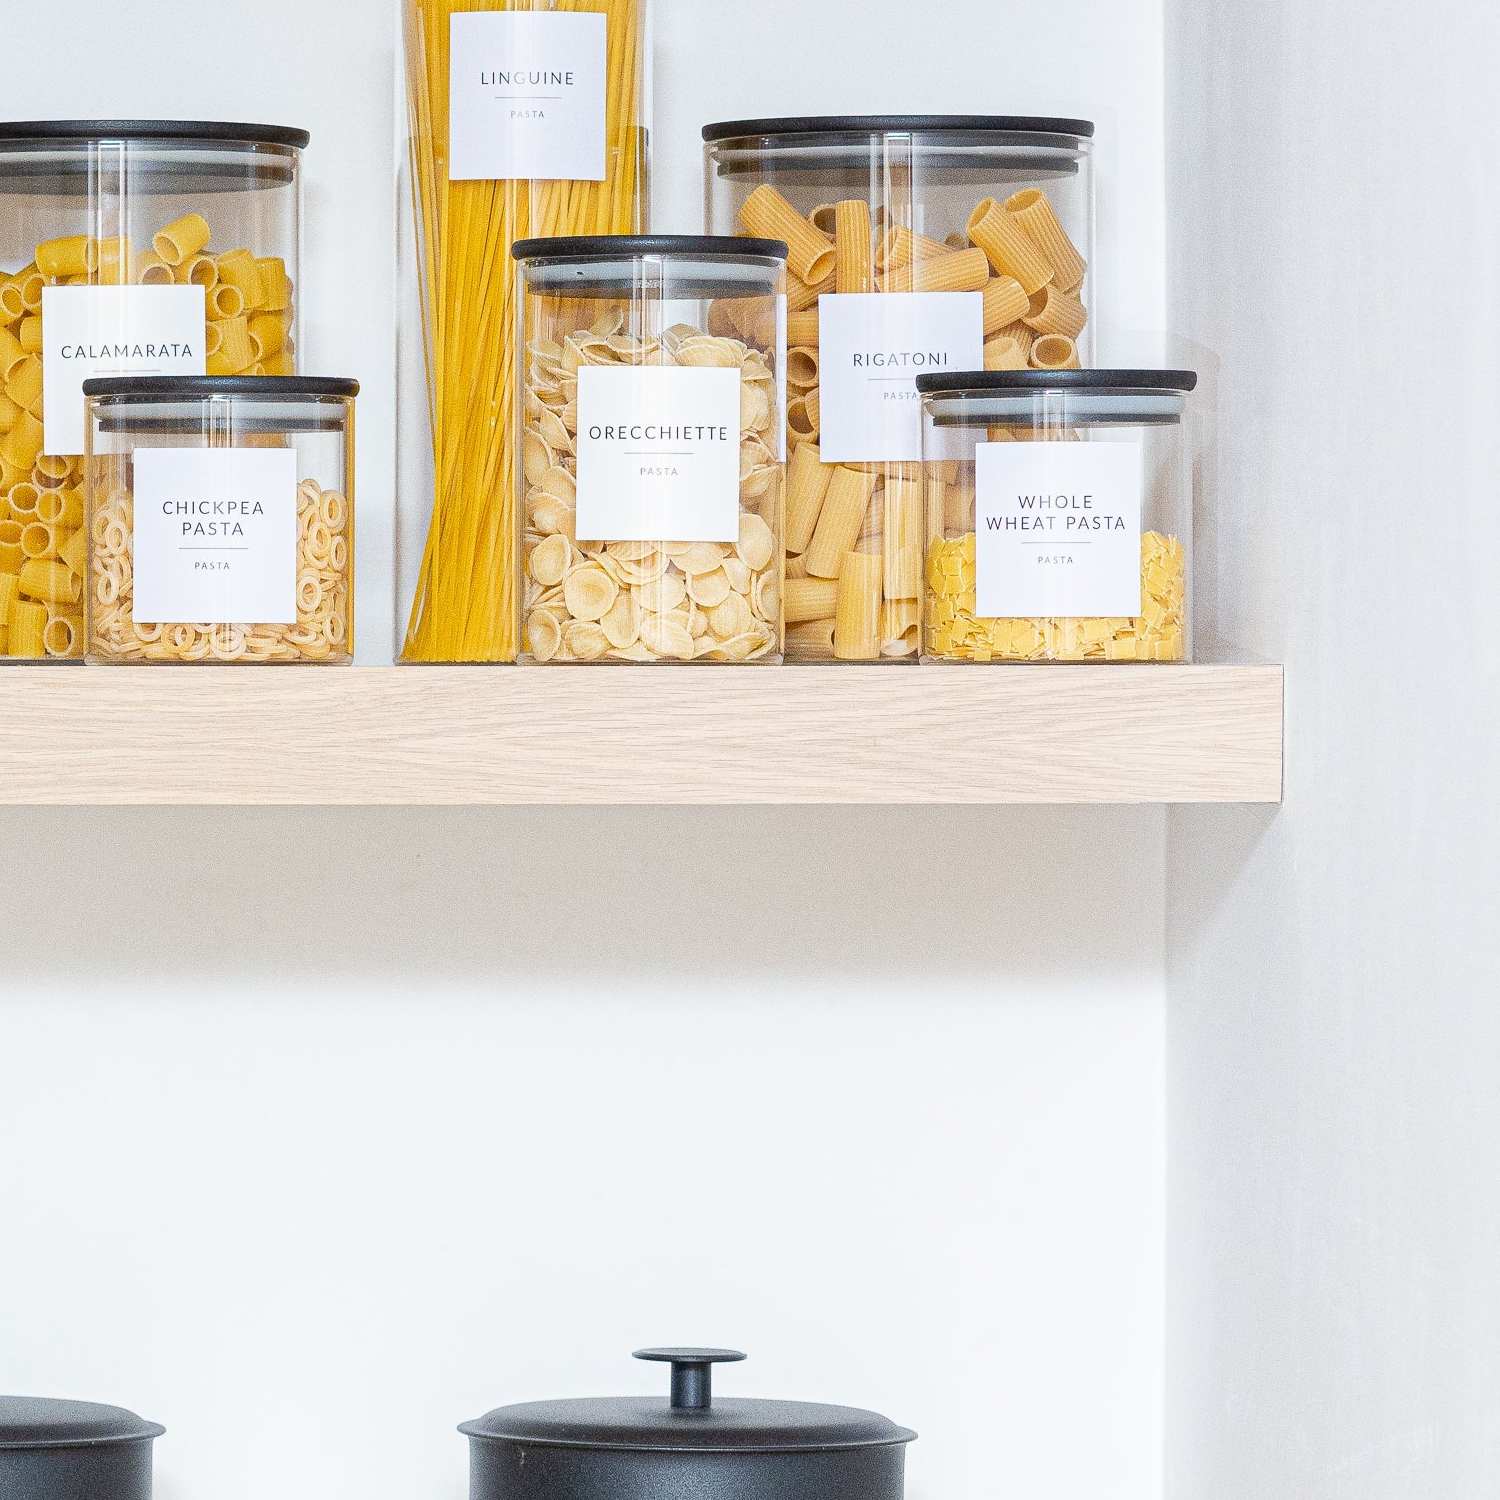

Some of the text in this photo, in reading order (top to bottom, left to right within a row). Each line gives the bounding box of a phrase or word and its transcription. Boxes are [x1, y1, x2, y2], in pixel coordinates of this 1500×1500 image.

[481, 69, 575, 86] LINGUINE
[510, 109, 545, 119] PASTA
[60, 342, 193, 360] CALAMARATA
[853, 350, 948, 368] RIGATONI
[883, 390, 920, 401] PASTA
[588, 424, 728, 441] ORECCHIETTE
[639, 466, 679, 476] PASTA
[162, 500, 264, 516] CHICKPEA
[1017, 494, 1093, 510] WHOLE
[182, 521, 244, 537] PASTA
[985, 515, 1126, 531] WHEAT PASTA
[194, 560, 230, 571] PASTA
[1037, 555, 1074, 565] PASTA
